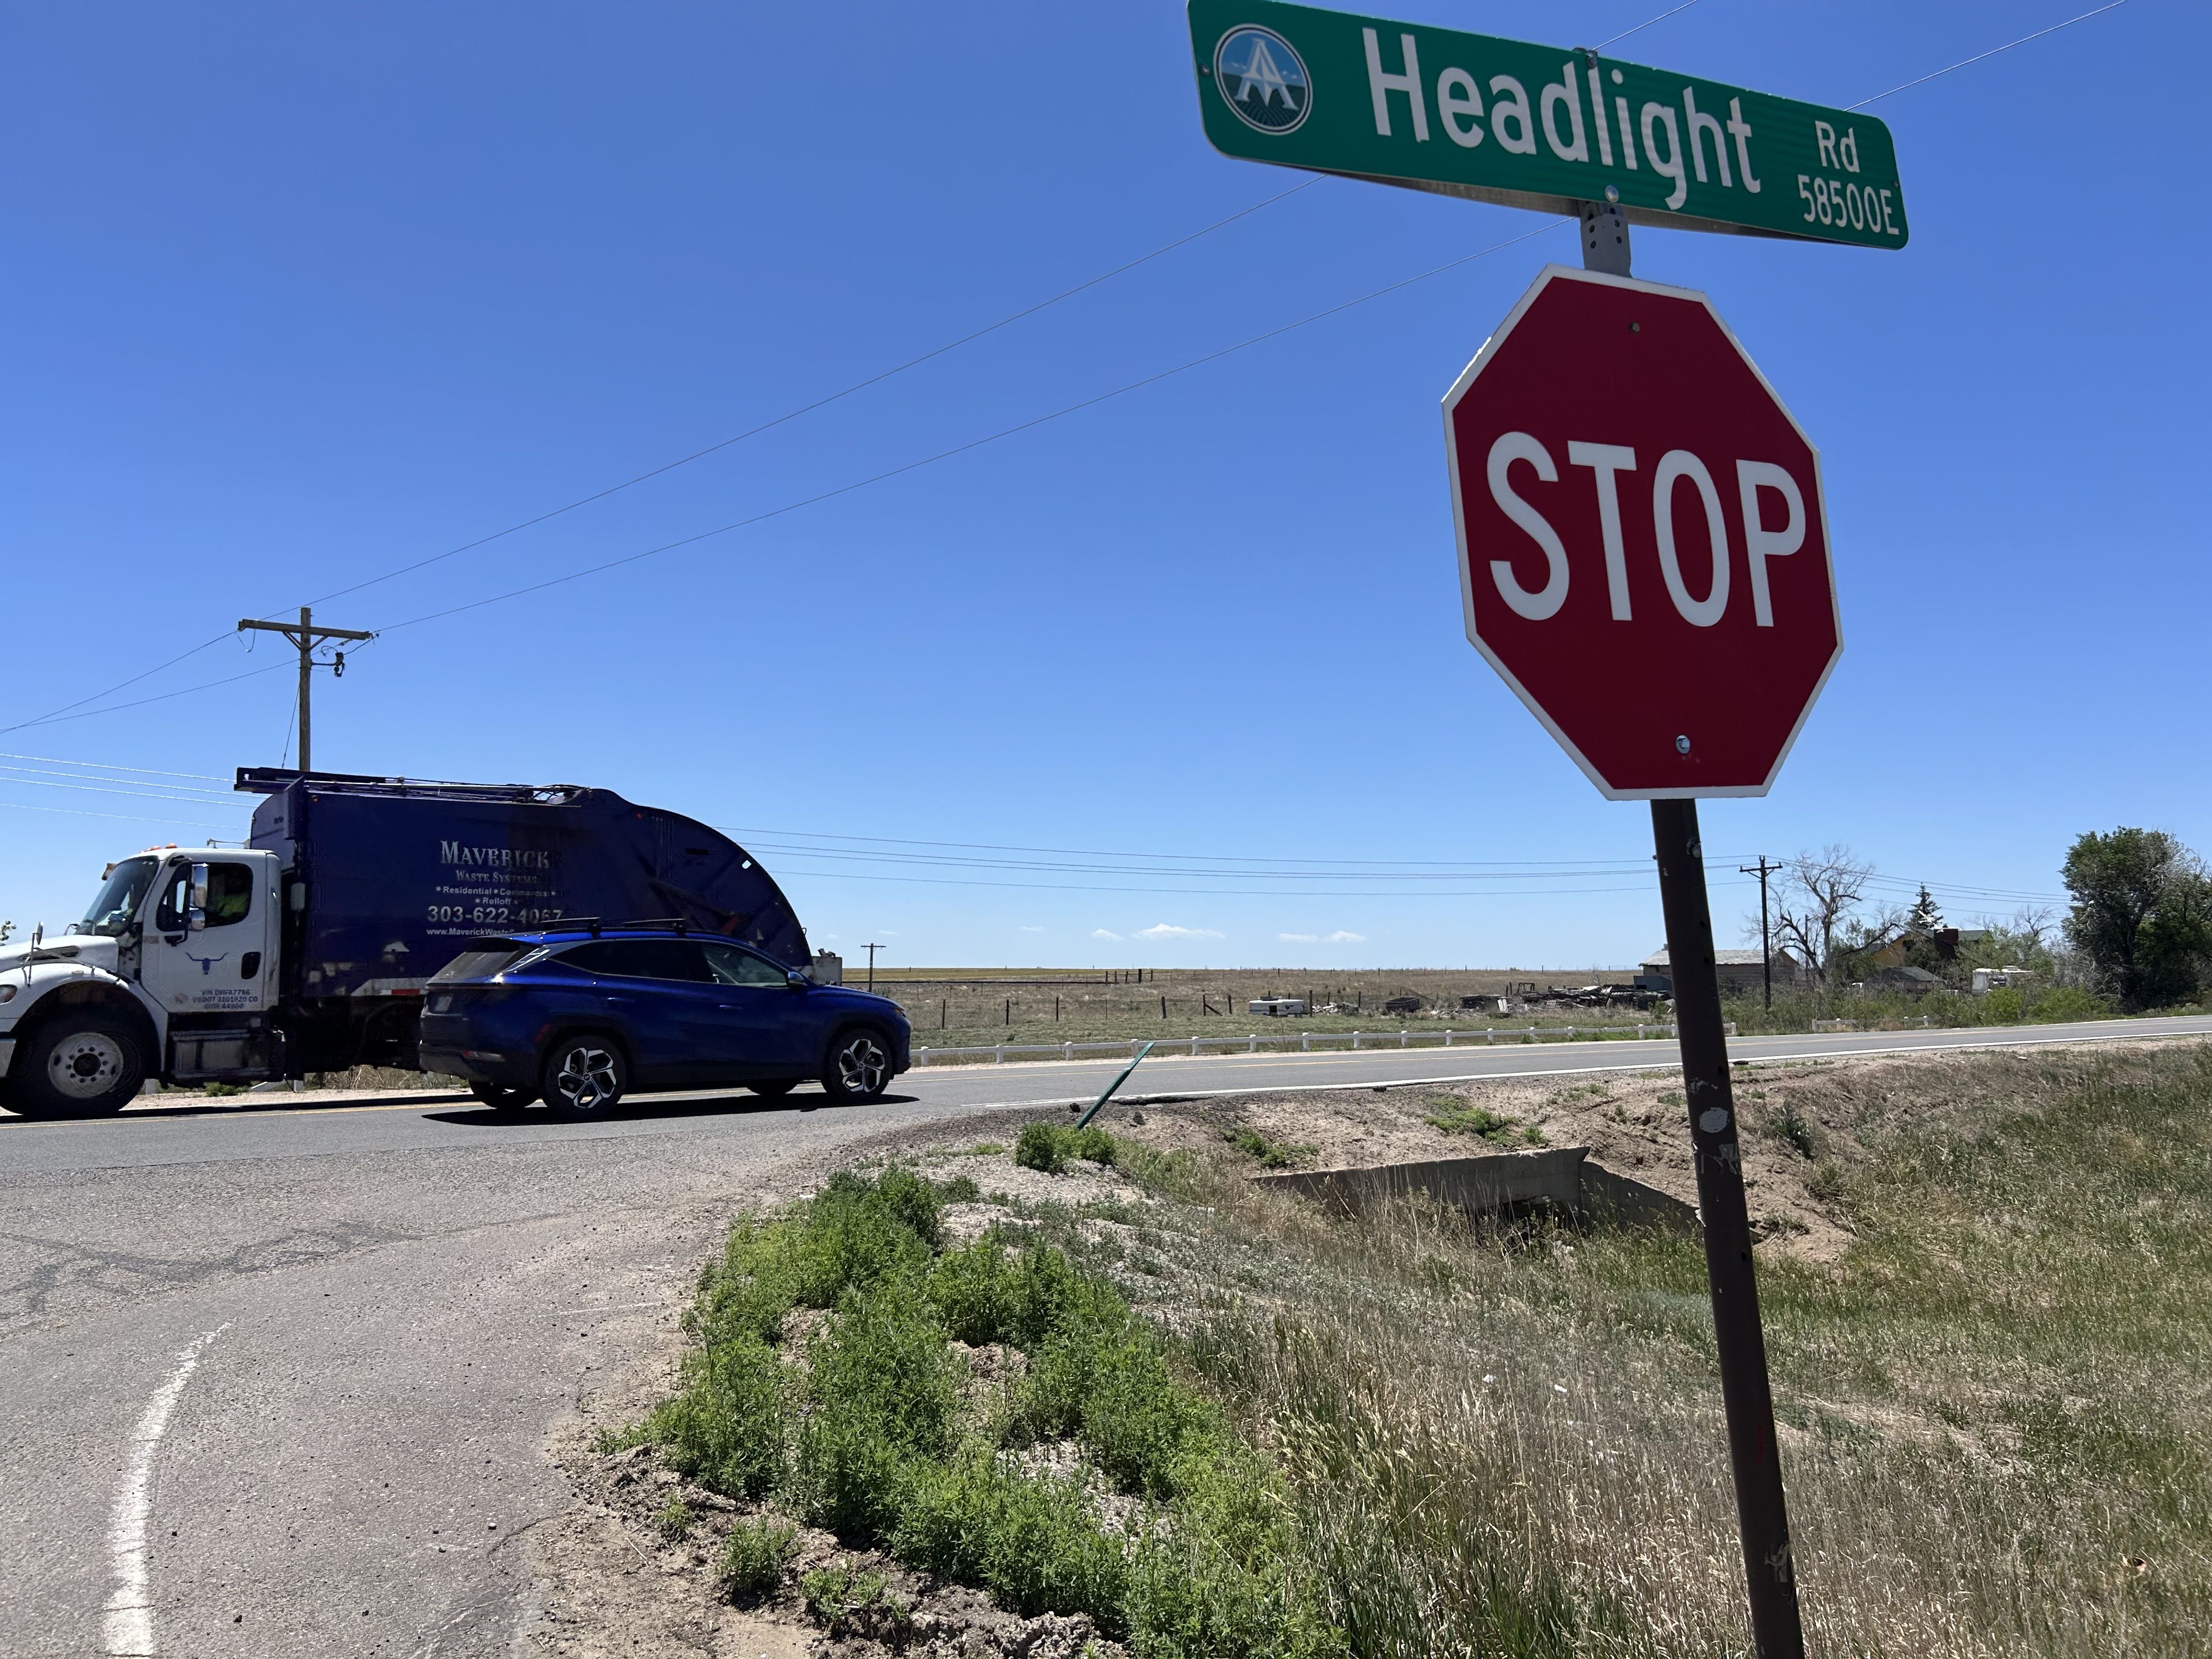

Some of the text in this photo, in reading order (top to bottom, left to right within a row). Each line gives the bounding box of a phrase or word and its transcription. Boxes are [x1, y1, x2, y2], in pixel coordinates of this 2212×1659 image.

[1362, 26, 1760, 211] Headlight
[1814, 119, 1859, 173] Rd
[1797, 174, 1900, 235] 58500E
[1486, 431, 1806, 627] STOP
[427, 905, 563, 924] 303-622-4067
[443, 885, 492, 895] Residential
